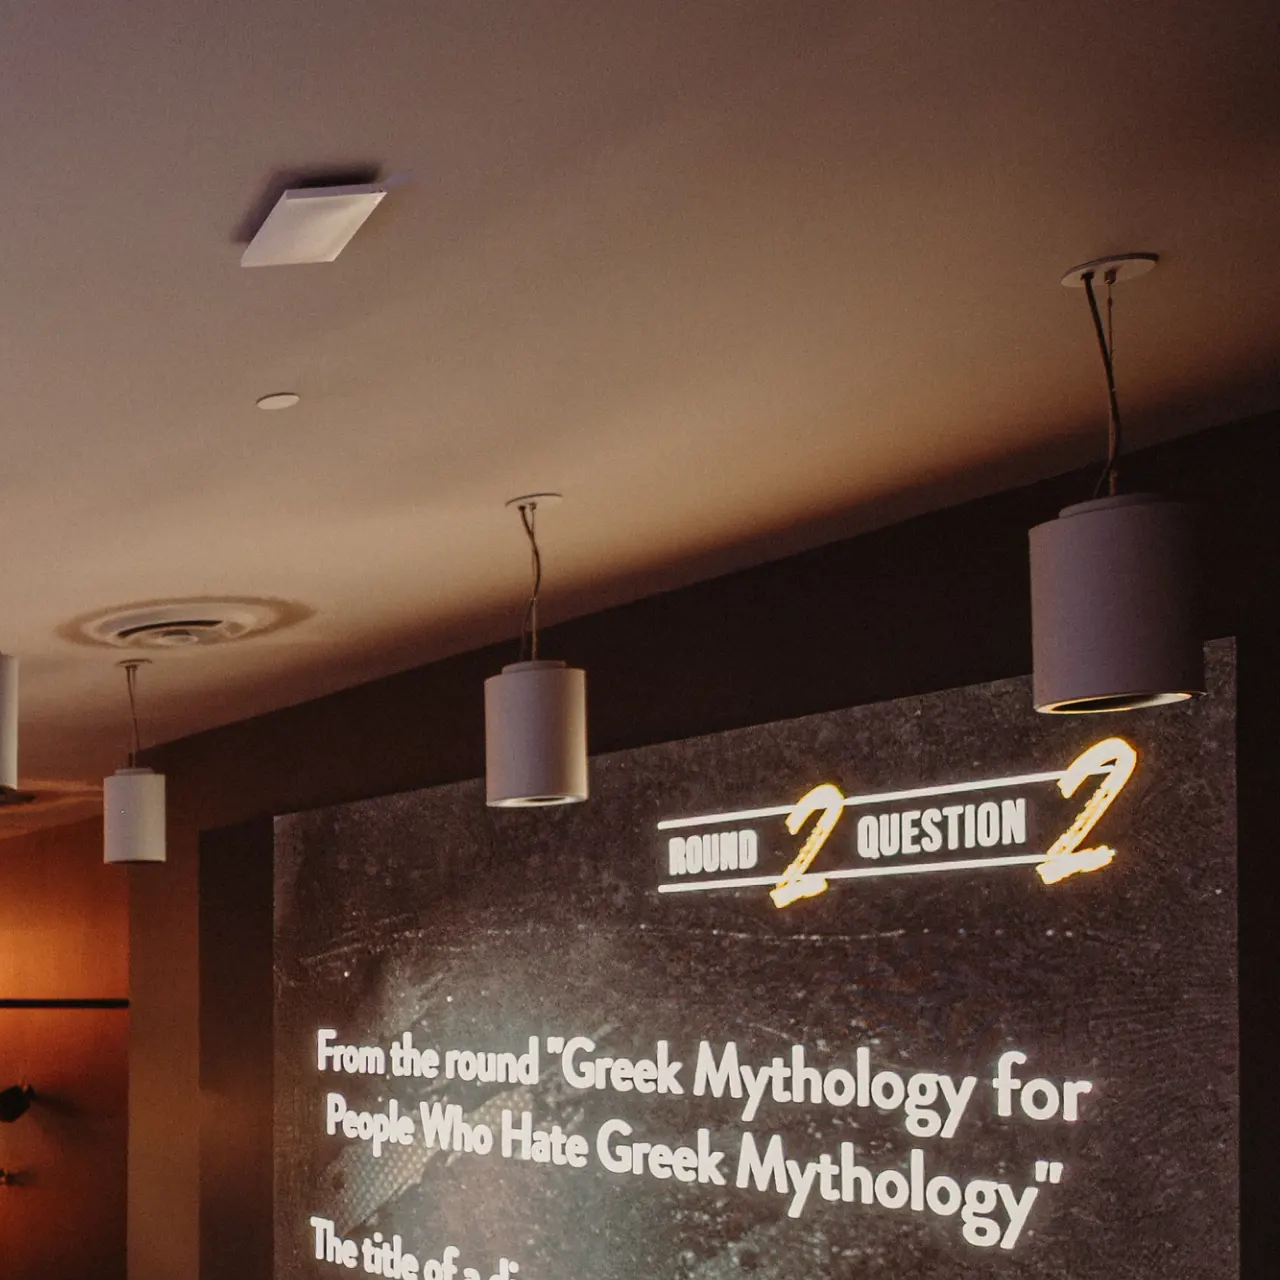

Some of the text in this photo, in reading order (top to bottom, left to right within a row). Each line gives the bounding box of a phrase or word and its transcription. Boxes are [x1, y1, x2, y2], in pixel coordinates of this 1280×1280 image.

[668, 737, 1138, 909] ROUND 2 QUESTION 2
[317, 1028, 1093, 1139] From the round "Greek Mythology for
[326, 1092, 1064, 1250] People Who Hate Greek Mythology"
[309, 1216, 359, 1269] The
